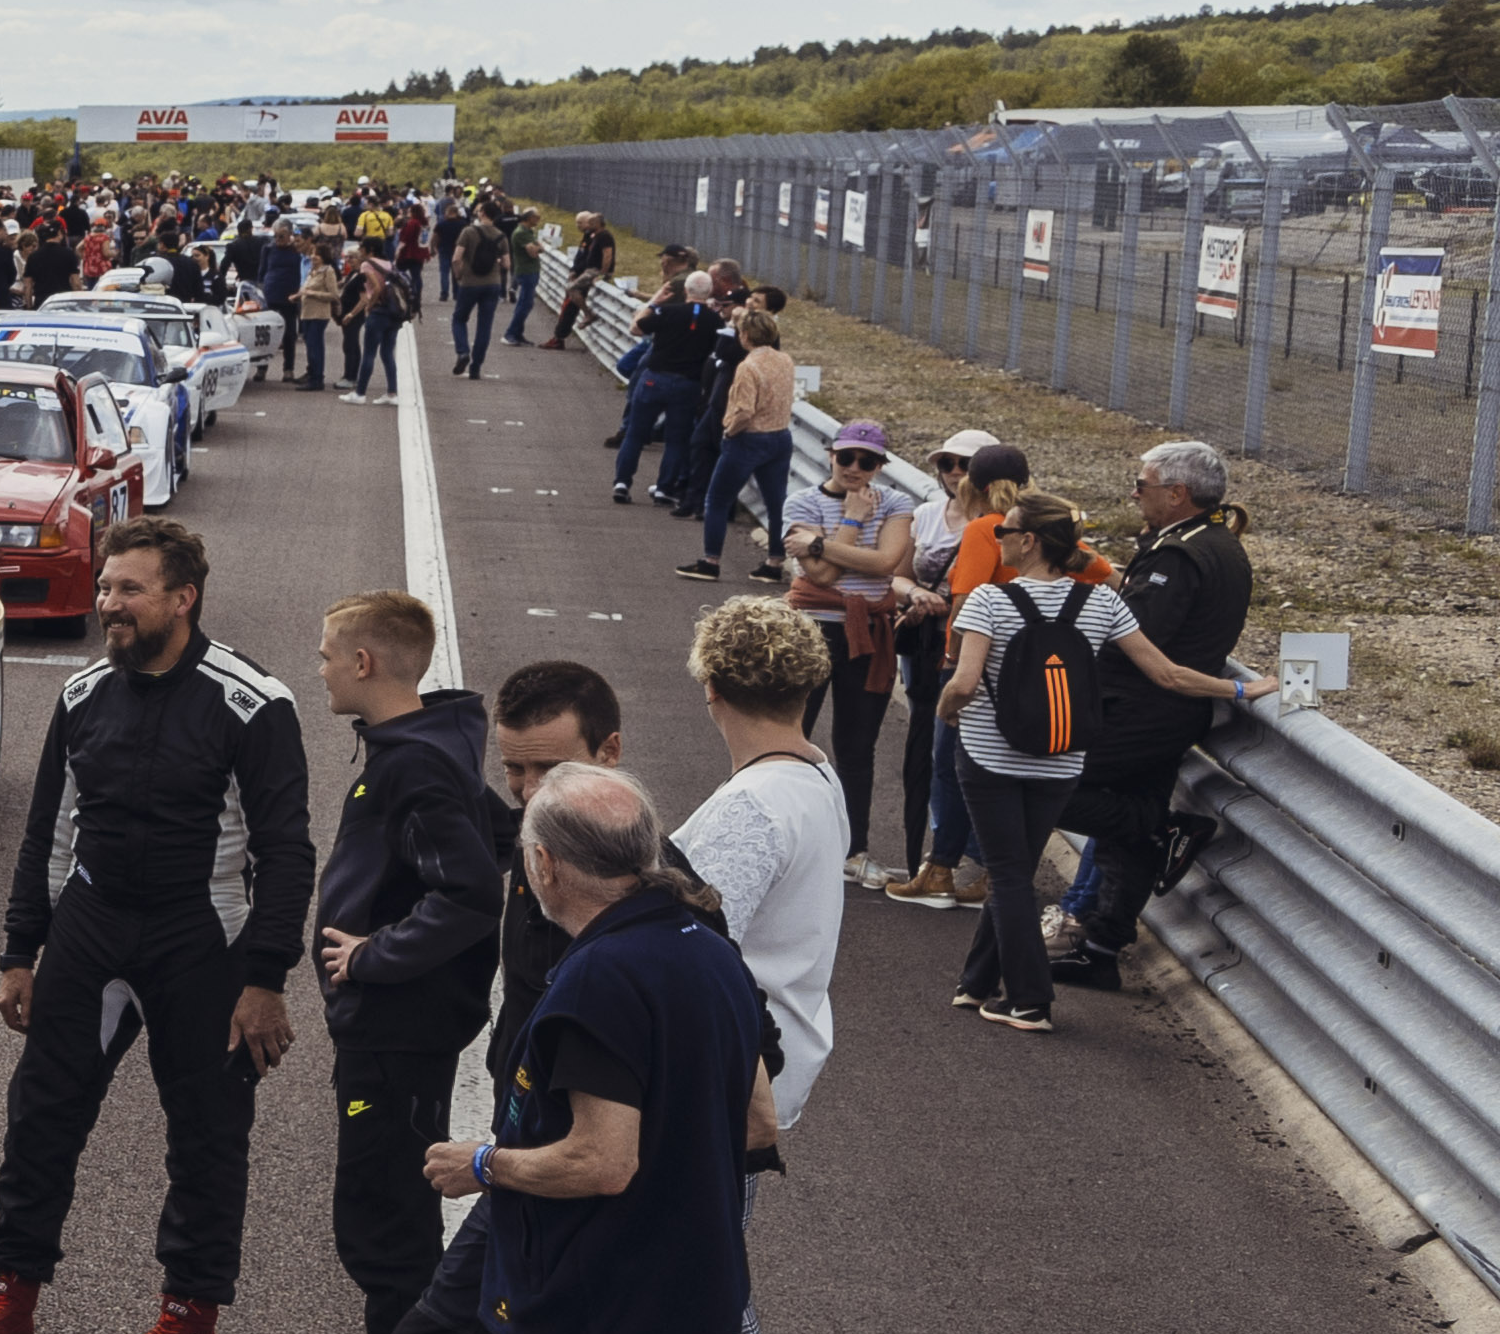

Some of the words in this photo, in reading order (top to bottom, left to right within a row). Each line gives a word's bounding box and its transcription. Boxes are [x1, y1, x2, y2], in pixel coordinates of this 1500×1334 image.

[138, 107, 188, 125] AVIA
[336, 105, 389, 125] AVIA
[111, 485, 128, 523] 87
[231, 690, 257, 712] OMP
